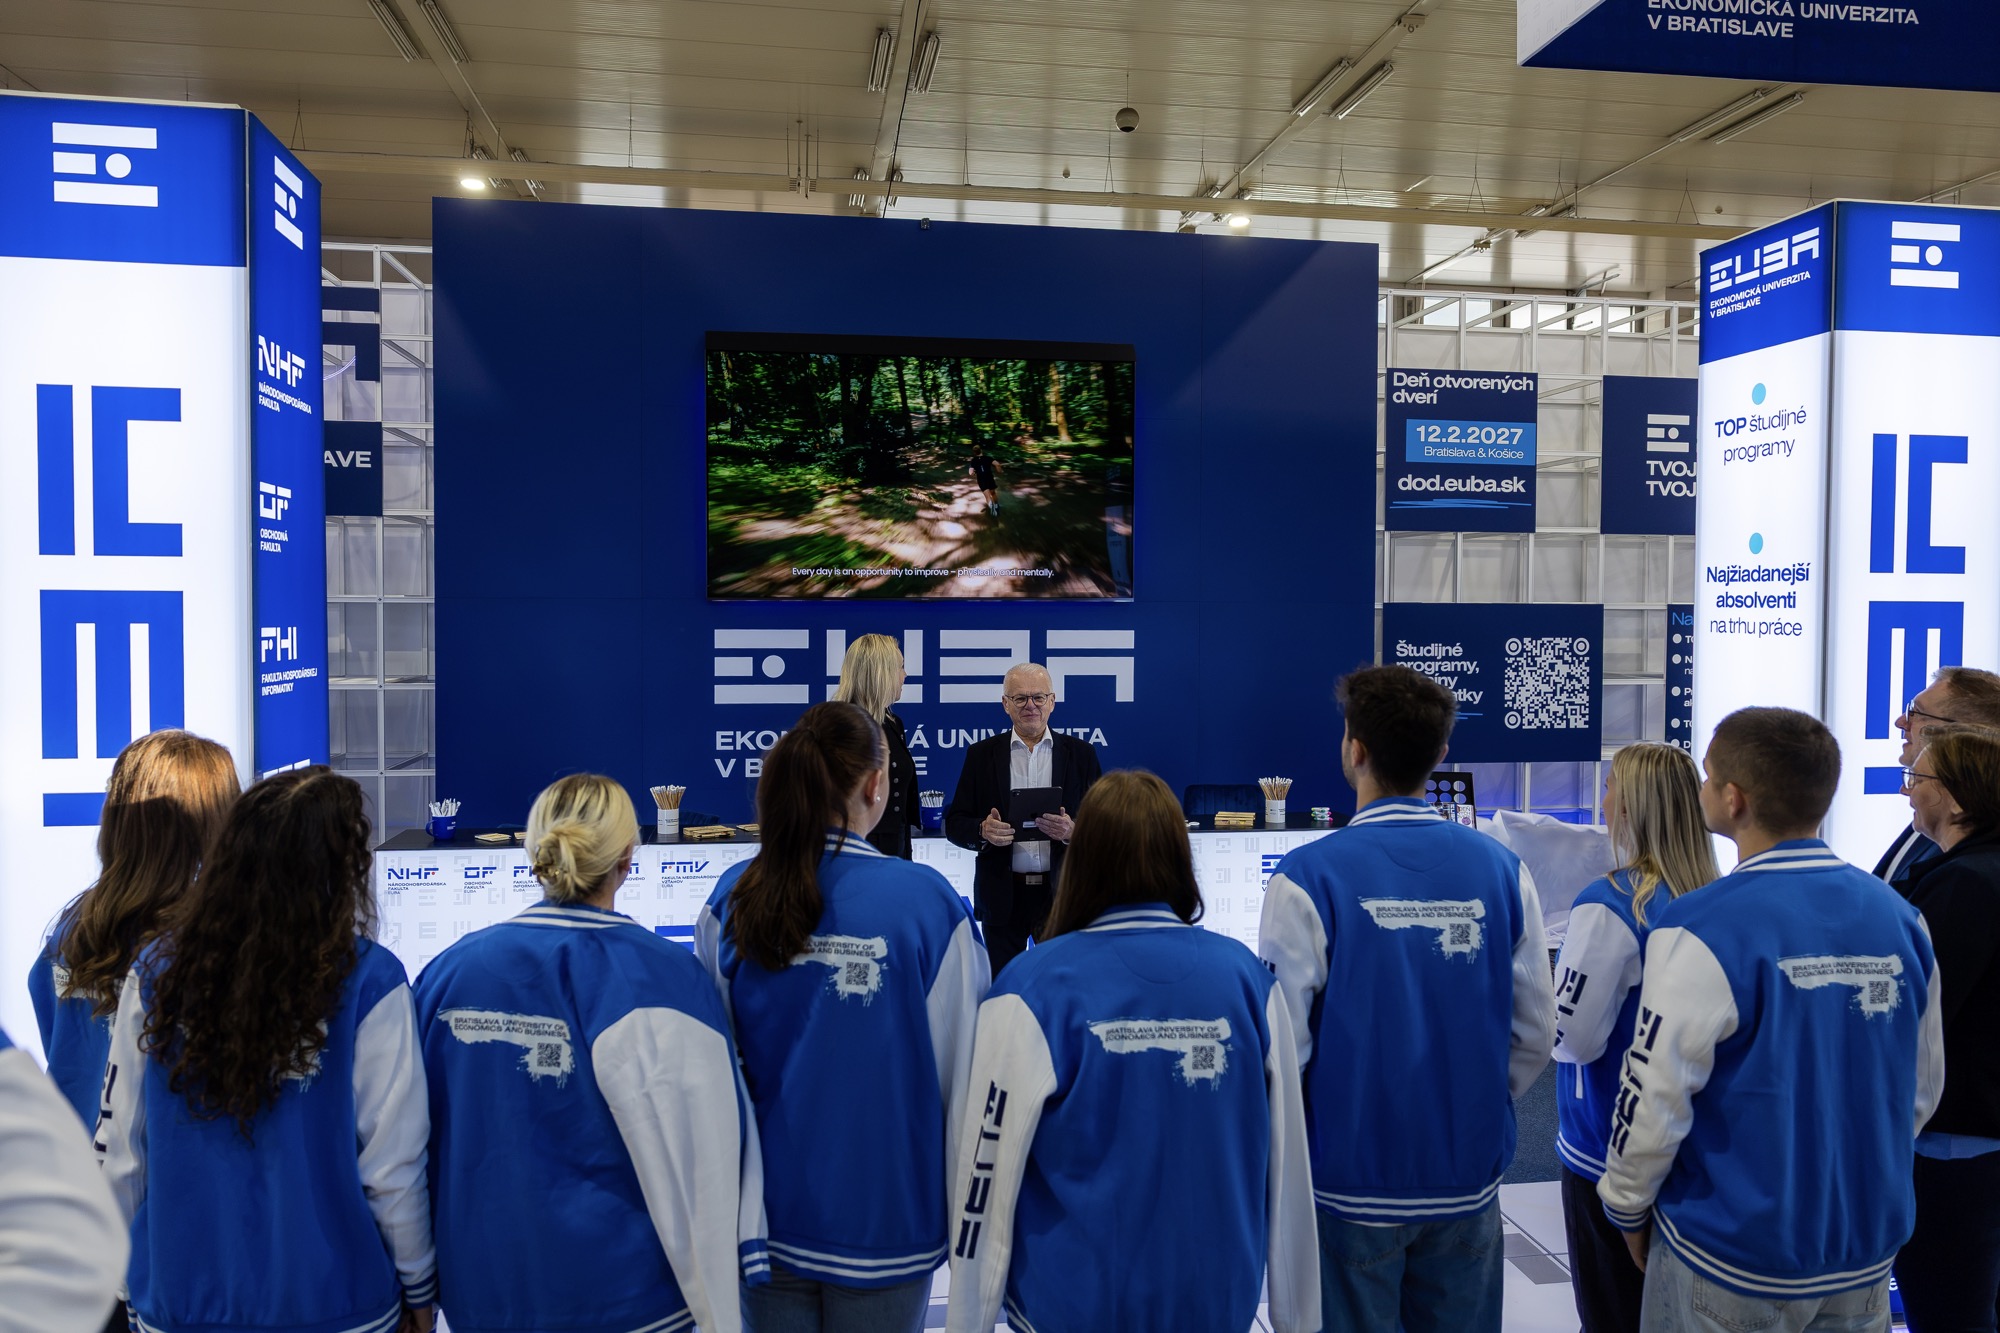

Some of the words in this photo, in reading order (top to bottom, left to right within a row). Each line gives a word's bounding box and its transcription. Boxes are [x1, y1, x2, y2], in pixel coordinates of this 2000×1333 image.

[1800, 3, 1919, 24] UNIVERZITA
[1648, 15, 1662, 30] V
[1668, 15, 1793, 38] BRATISLAVE
[1710, 284, 1762, 309] EKONOMICKÁ
[1762, 270, 1811, 293] UNIVERZITA
[1710, 311, 1717, 319] V
[1716, 297, 1761, 317] BRATISLAVE
[258, 334, 305, 388] NHF
[1393, 372, 1430, 388] Deň
[1433, 374, 1534, 394] otvorených
[258, 382, 312, 415] NÁRODOHOSPODÁRSKA
[258, 394, 281, 413] FAKULTA
[1392, 389, 1439, 404] dverí
[1714, 417, 1748, 438] TOP
[1749, 406, 1807, 433] študijné
[1416, 425, 1524, 445] 12.2.2027
[1424, 446, 1476, 458] Bratislava
[1478, 448, 1486, 458] &
[1488, 448, 1524, 459] Košice
[1724, 438, 1796, 466] programy
[1398, 474, 1526, 493] dod.euba.sk
[260, 528, 288, 542] OBCHODNÁ
[260, 541, 282, 553] FAKULTA
[792, 567, 815, 578] Every
[816, 567, 832, 577] day
[834, 568, 840, 576] is
[854, 568, 904, 578] opportunity
[904, 568, 914, 576] to
[914, 568, 949, 578] improve
[958, 567, 998, 578] physically
[999, 568, 1016, 576] and
[1017, 568, 1054, 578] mentally.
[1706, 562, 1811, 586] Najžiadanejší
[1716, 591, 1797, 609] absolventi
[1710, 619, 1727, 634] na
[1729, 616, 1756, 634] trhu
[1758, 617, 1802, 638] práce
[260, 626, 298, 663] FHI
[1396, 640, 1464, 660] Študijné
[262, 672, 282, 684] FAKULTA
[282, 667, 318, 681] HOSPODÁRSKEJ
[262, 682, 294, 696] INFORMATIKY
[714, 758, 736, 778] V
[388, 868, 439, 880] NHF
[662, 861, 710, 874] FMV
[814, 941, 860, 950] UNIVERSITY
[834, 948, 877, 958] BUSINESS
[1792, 964, 1832, 972] BRATISLAVA
[1792, 970, 1834, 978] ECONOMICS
[454, 1024, 502, 1032] ECONOMICS
[504, 1026, 523, 1034] AND
[524, 1028, 567, 1038] BUSINESS
[502, 1020, 553, 1030] UNIVERSITY
[554, 1024, 565, 1032] OF
[1106, 1026, 1152, 1034] BRATISLAVA
[1105, 1033, 1156, 1042] ECONOMICS
[1157, 1032, 1176, 1040] AND
